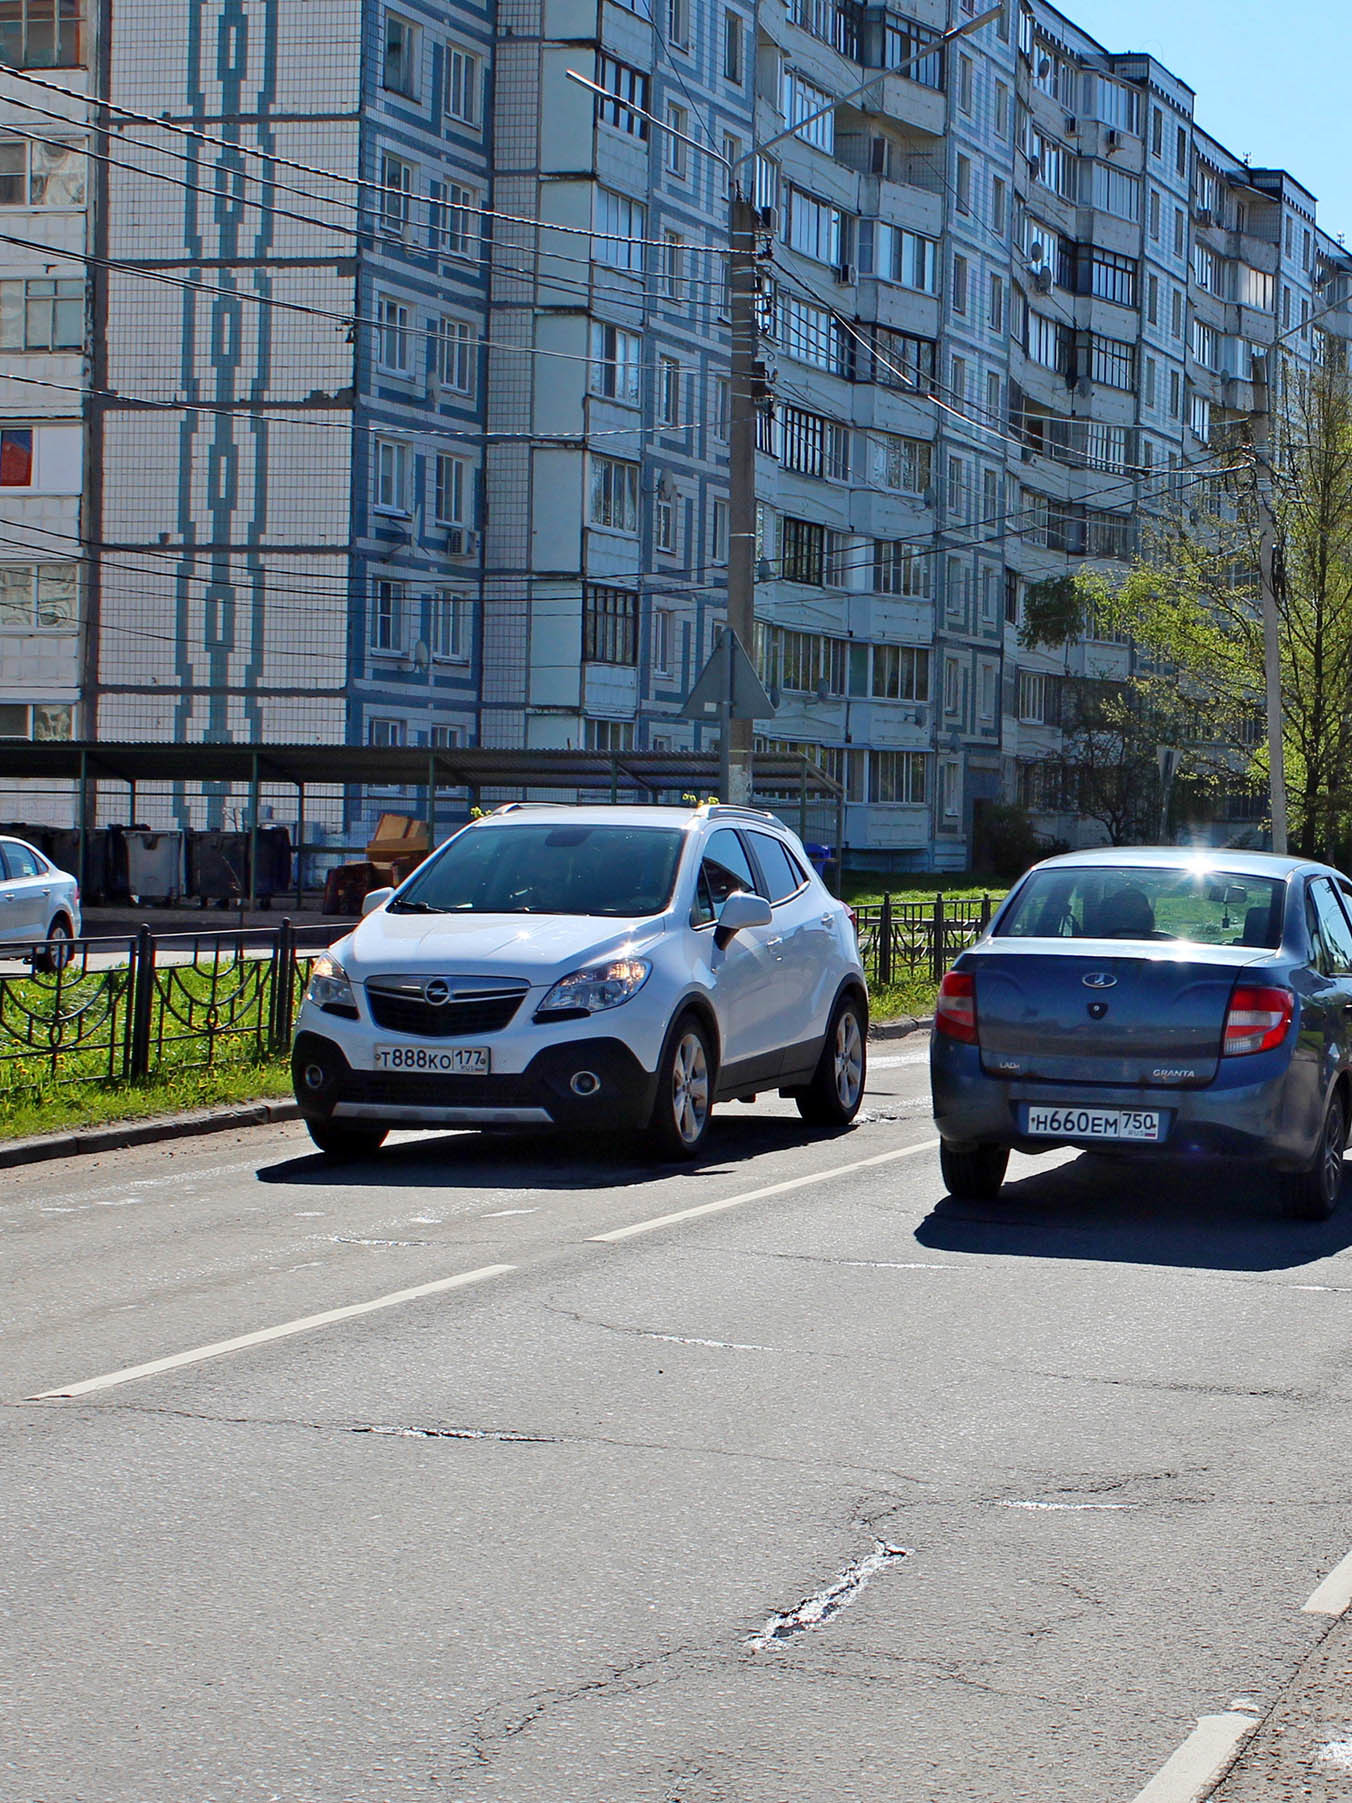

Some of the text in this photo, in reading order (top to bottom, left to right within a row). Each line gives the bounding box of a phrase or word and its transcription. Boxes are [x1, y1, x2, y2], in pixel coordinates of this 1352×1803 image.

[455, 1050, 482, 1065] 177
[1152, 1069, 1195, 1078] GRANTA
[1122, 1112, 1155, 1130] 750
